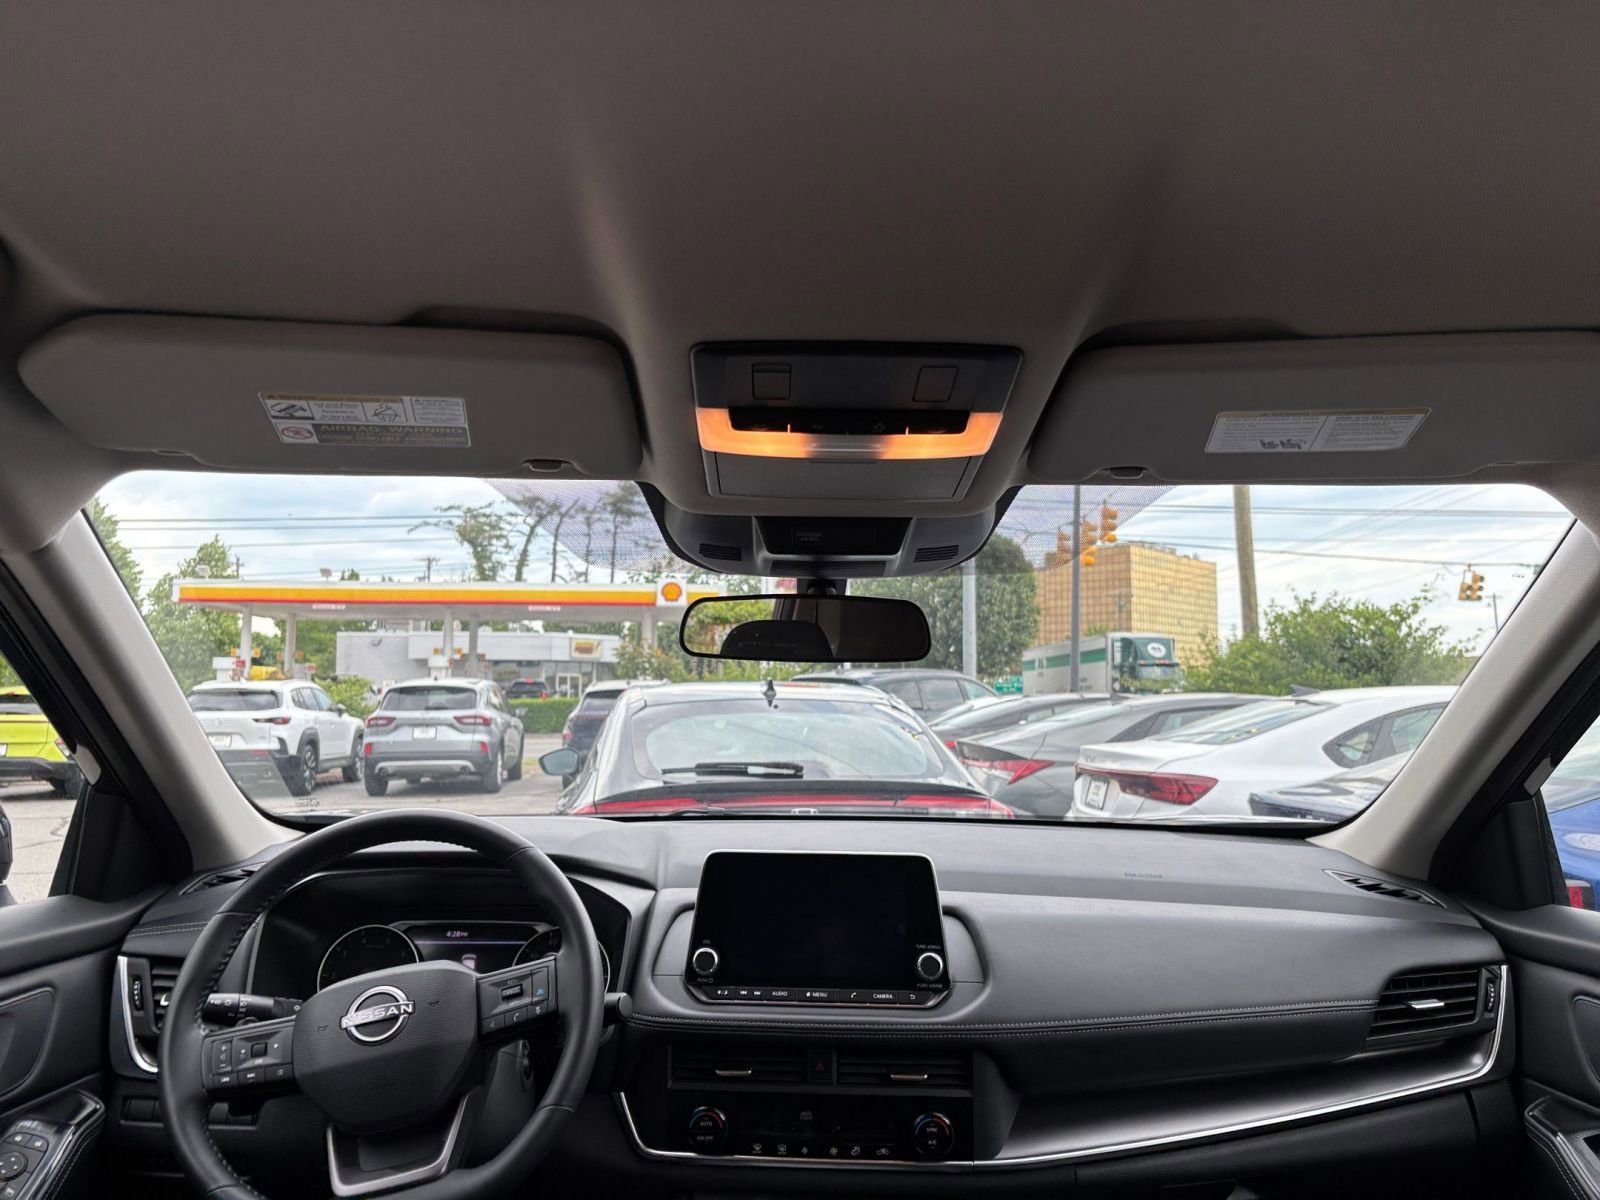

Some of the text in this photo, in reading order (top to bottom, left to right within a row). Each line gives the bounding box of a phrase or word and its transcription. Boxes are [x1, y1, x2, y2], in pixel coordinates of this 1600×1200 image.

[320, 425, 463, 433] AIRBAG WARNING
[342, 1003, 413, 1029] NISSAN
